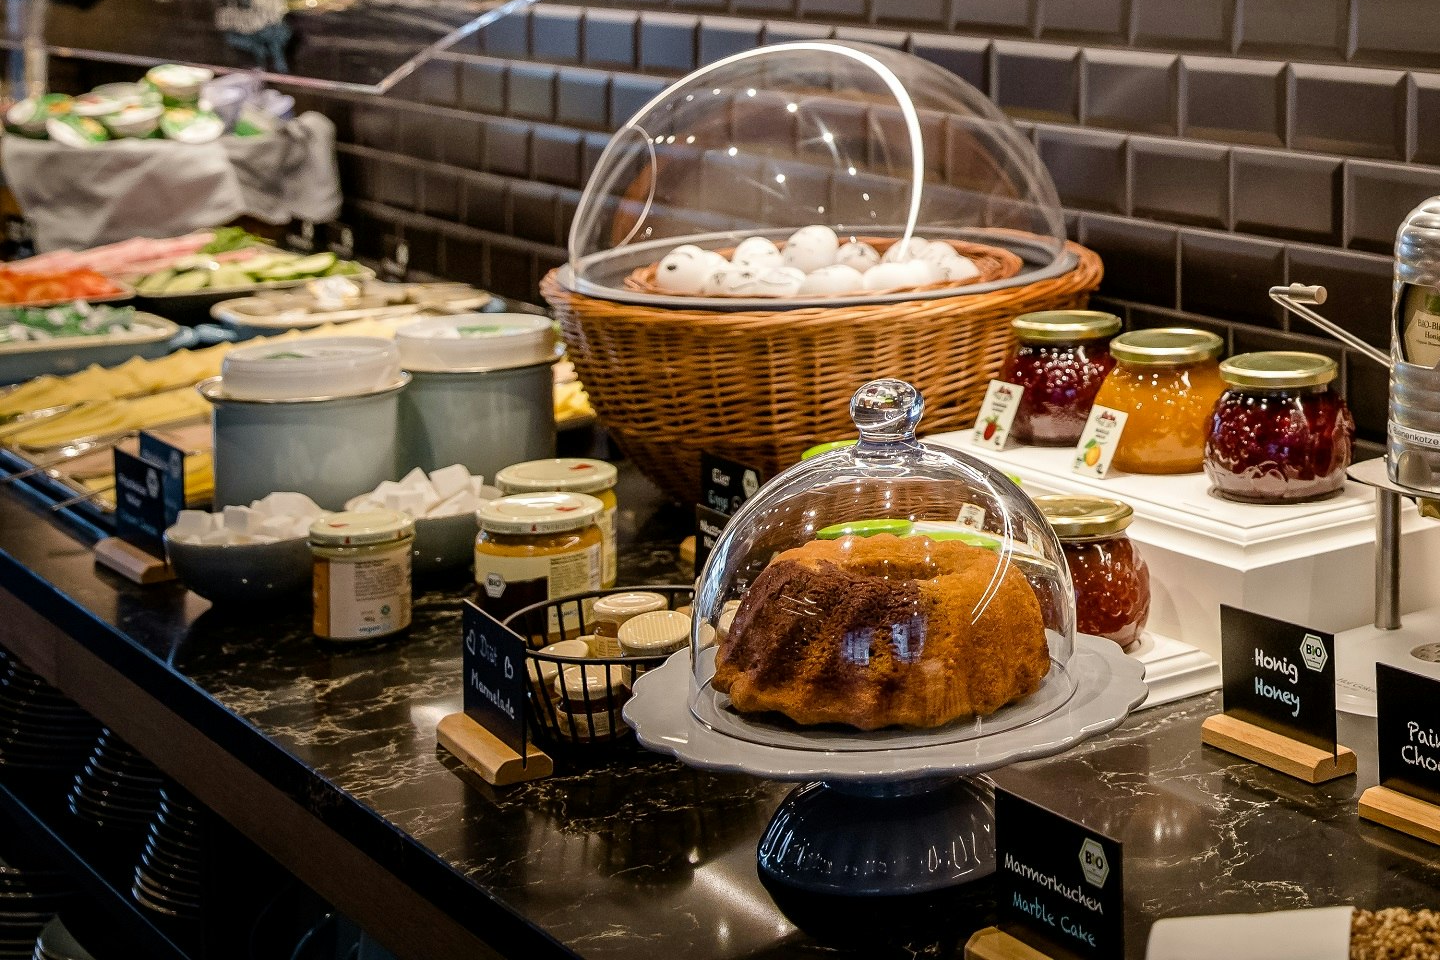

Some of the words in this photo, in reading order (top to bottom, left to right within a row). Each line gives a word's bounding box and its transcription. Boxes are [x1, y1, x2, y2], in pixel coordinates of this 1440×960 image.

[1254, 647, 1299, 685] Honig
[1254, 676, 1300, 718] Honey
[1004, 852, 1104, 915] Marmorkuchen
[1012, 891, 1056, 926] Marble
[1060, 916, 1096, 947] Cake
